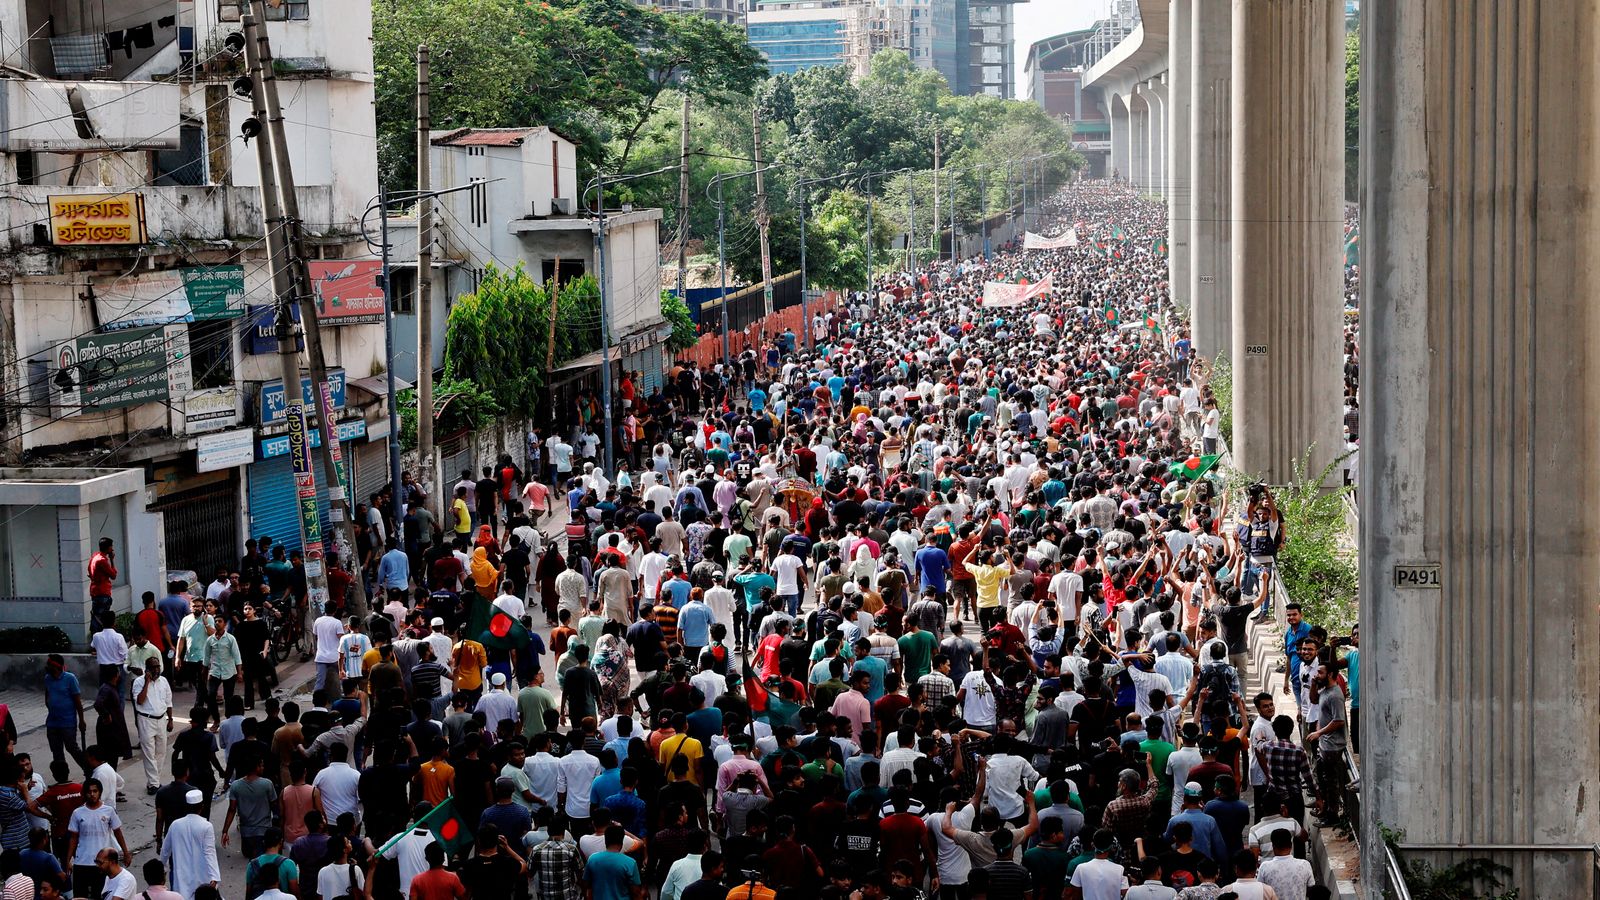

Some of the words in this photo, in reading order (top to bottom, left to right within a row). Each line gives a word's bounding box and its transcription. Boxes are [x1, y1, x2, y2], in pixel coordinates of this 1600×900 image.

[55, 201, 129, 218] সাদমান
[57, 220, 131, 241] হলিডেজ
[1246, 346, 1267, 354] P490
[1398, 570, 1440, 585] P491
